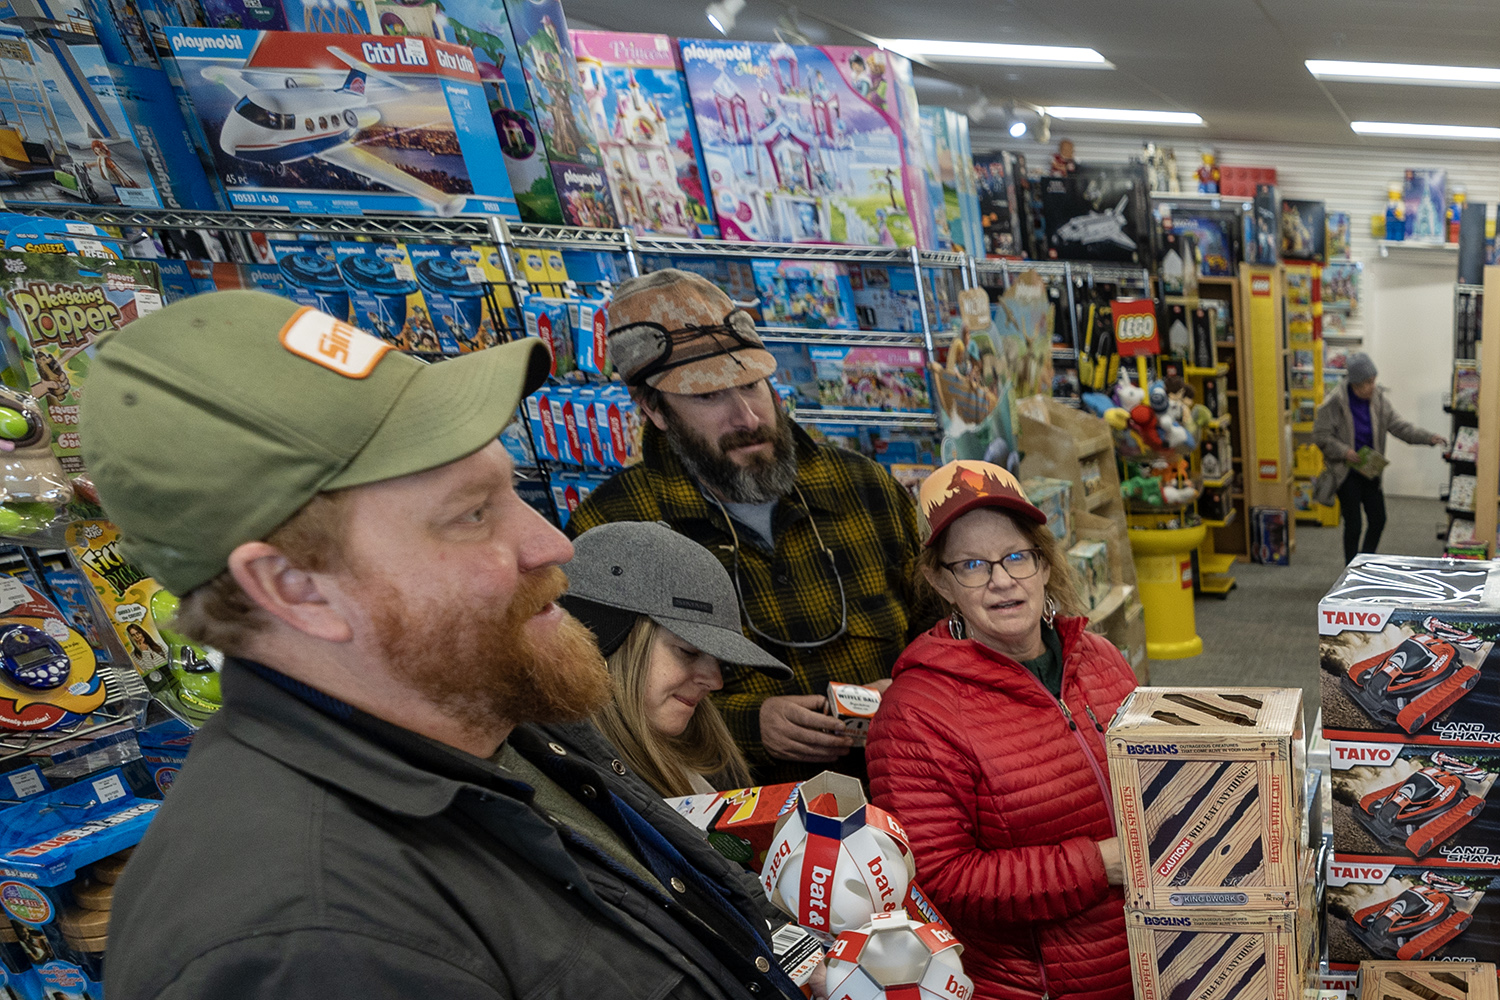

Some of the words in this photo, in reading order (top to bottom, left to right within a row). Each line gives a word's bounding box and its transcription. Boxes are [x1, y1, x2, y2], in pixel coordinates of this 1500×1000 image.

[172, 33, 244, 52] playmobil
[682, 42, 752, 63] playmobil
[361, 41, 398, 65] City
[436, 49, 456, 70] City
[455, 55, 476, 75] Life
[135, 125, 182, 209] playmobil
[225, 173, 237, 185] 45
[238, 177, 249, 186] PC
[563, 168, 603, 188] playmobil
[232, 192, 255, 204] 70533
[260, 194, 280, 204] 4-10
[25, 242, 68, 254] SQUEEZE
[336, 246, 366, 255] playmobil
[411, 249, 441, 258] playmobil
[107, 272, 136, 283] SHOOTS
[33, 285, 105, 309] Hedgehog
[14, 292, 122, 344] Popper
[1117, 314, 1155, 340] LEGO
[53, 415, 64, 424] TO
[57, 433, 67, 449] 6
[1322, 610, 1382, 627] TAIYO
[837, 693, 862, 701] WIFFLE
[1433, 721, 1484, 733] LAND
[1126, 744, 1179, 755] BOGLINS
[1335, 747, 1392, 762] TAIYO
[1273, 774, 1281, 799] CARE
[1123, 786, 1136, 826] SPECIES
[1272, 800, 1280, 827] WITH
[5, 802, 161, 858] TrueBalance
[1160, 839, 1192, 876] CAUTION:
[1188, 822, 1206, 840] WILL
[1203, 807, 1220, 823] EAT
[1217, 766, 1251, 807] ANYTHING!
[1271, 828, 1280, 863] HANDLE
[1439, 846, 1490, 856] LAND
[772, 839, 792, 876] bat
[1131, 826, 1146, 889] ENDANGERED
[1330, 867, 1384, 880] TAIYO
[809, 865, 832, 914] bat
[867, 856, 894, 901] bat
[883, 900, 896, 913] &
[1184, 894, 1206, 903] KING
[809, 914, 825, 927] &
[1144, 916, 1192, 927] BOGLINS
[1140, 952, 1152, 989] SPECIES
[1200, 984, 1217, 1000] WILL
[1215, 972, 1230, 987] EAT
[1227, 937, 1259, 973] ANYTHING!
